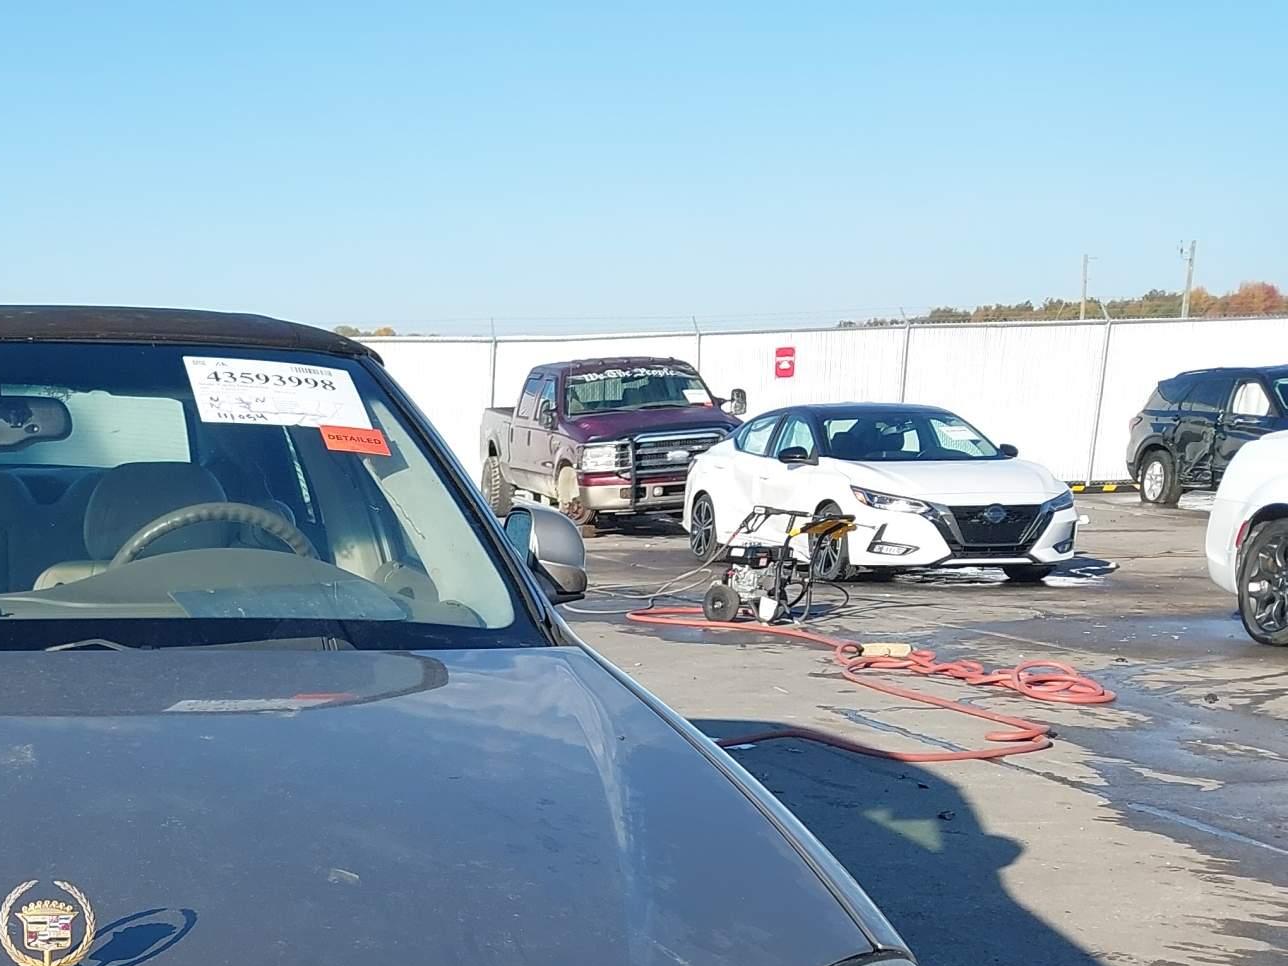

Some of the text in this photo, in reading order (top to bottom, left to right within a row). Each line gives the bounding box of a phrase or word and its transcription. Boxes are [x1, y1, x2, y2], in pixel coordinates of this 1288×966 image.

[207, 371, 337, 391] 43593998
[583, 368, 675, 381] We The People
[328, 434, 382, 445] DETAILED
